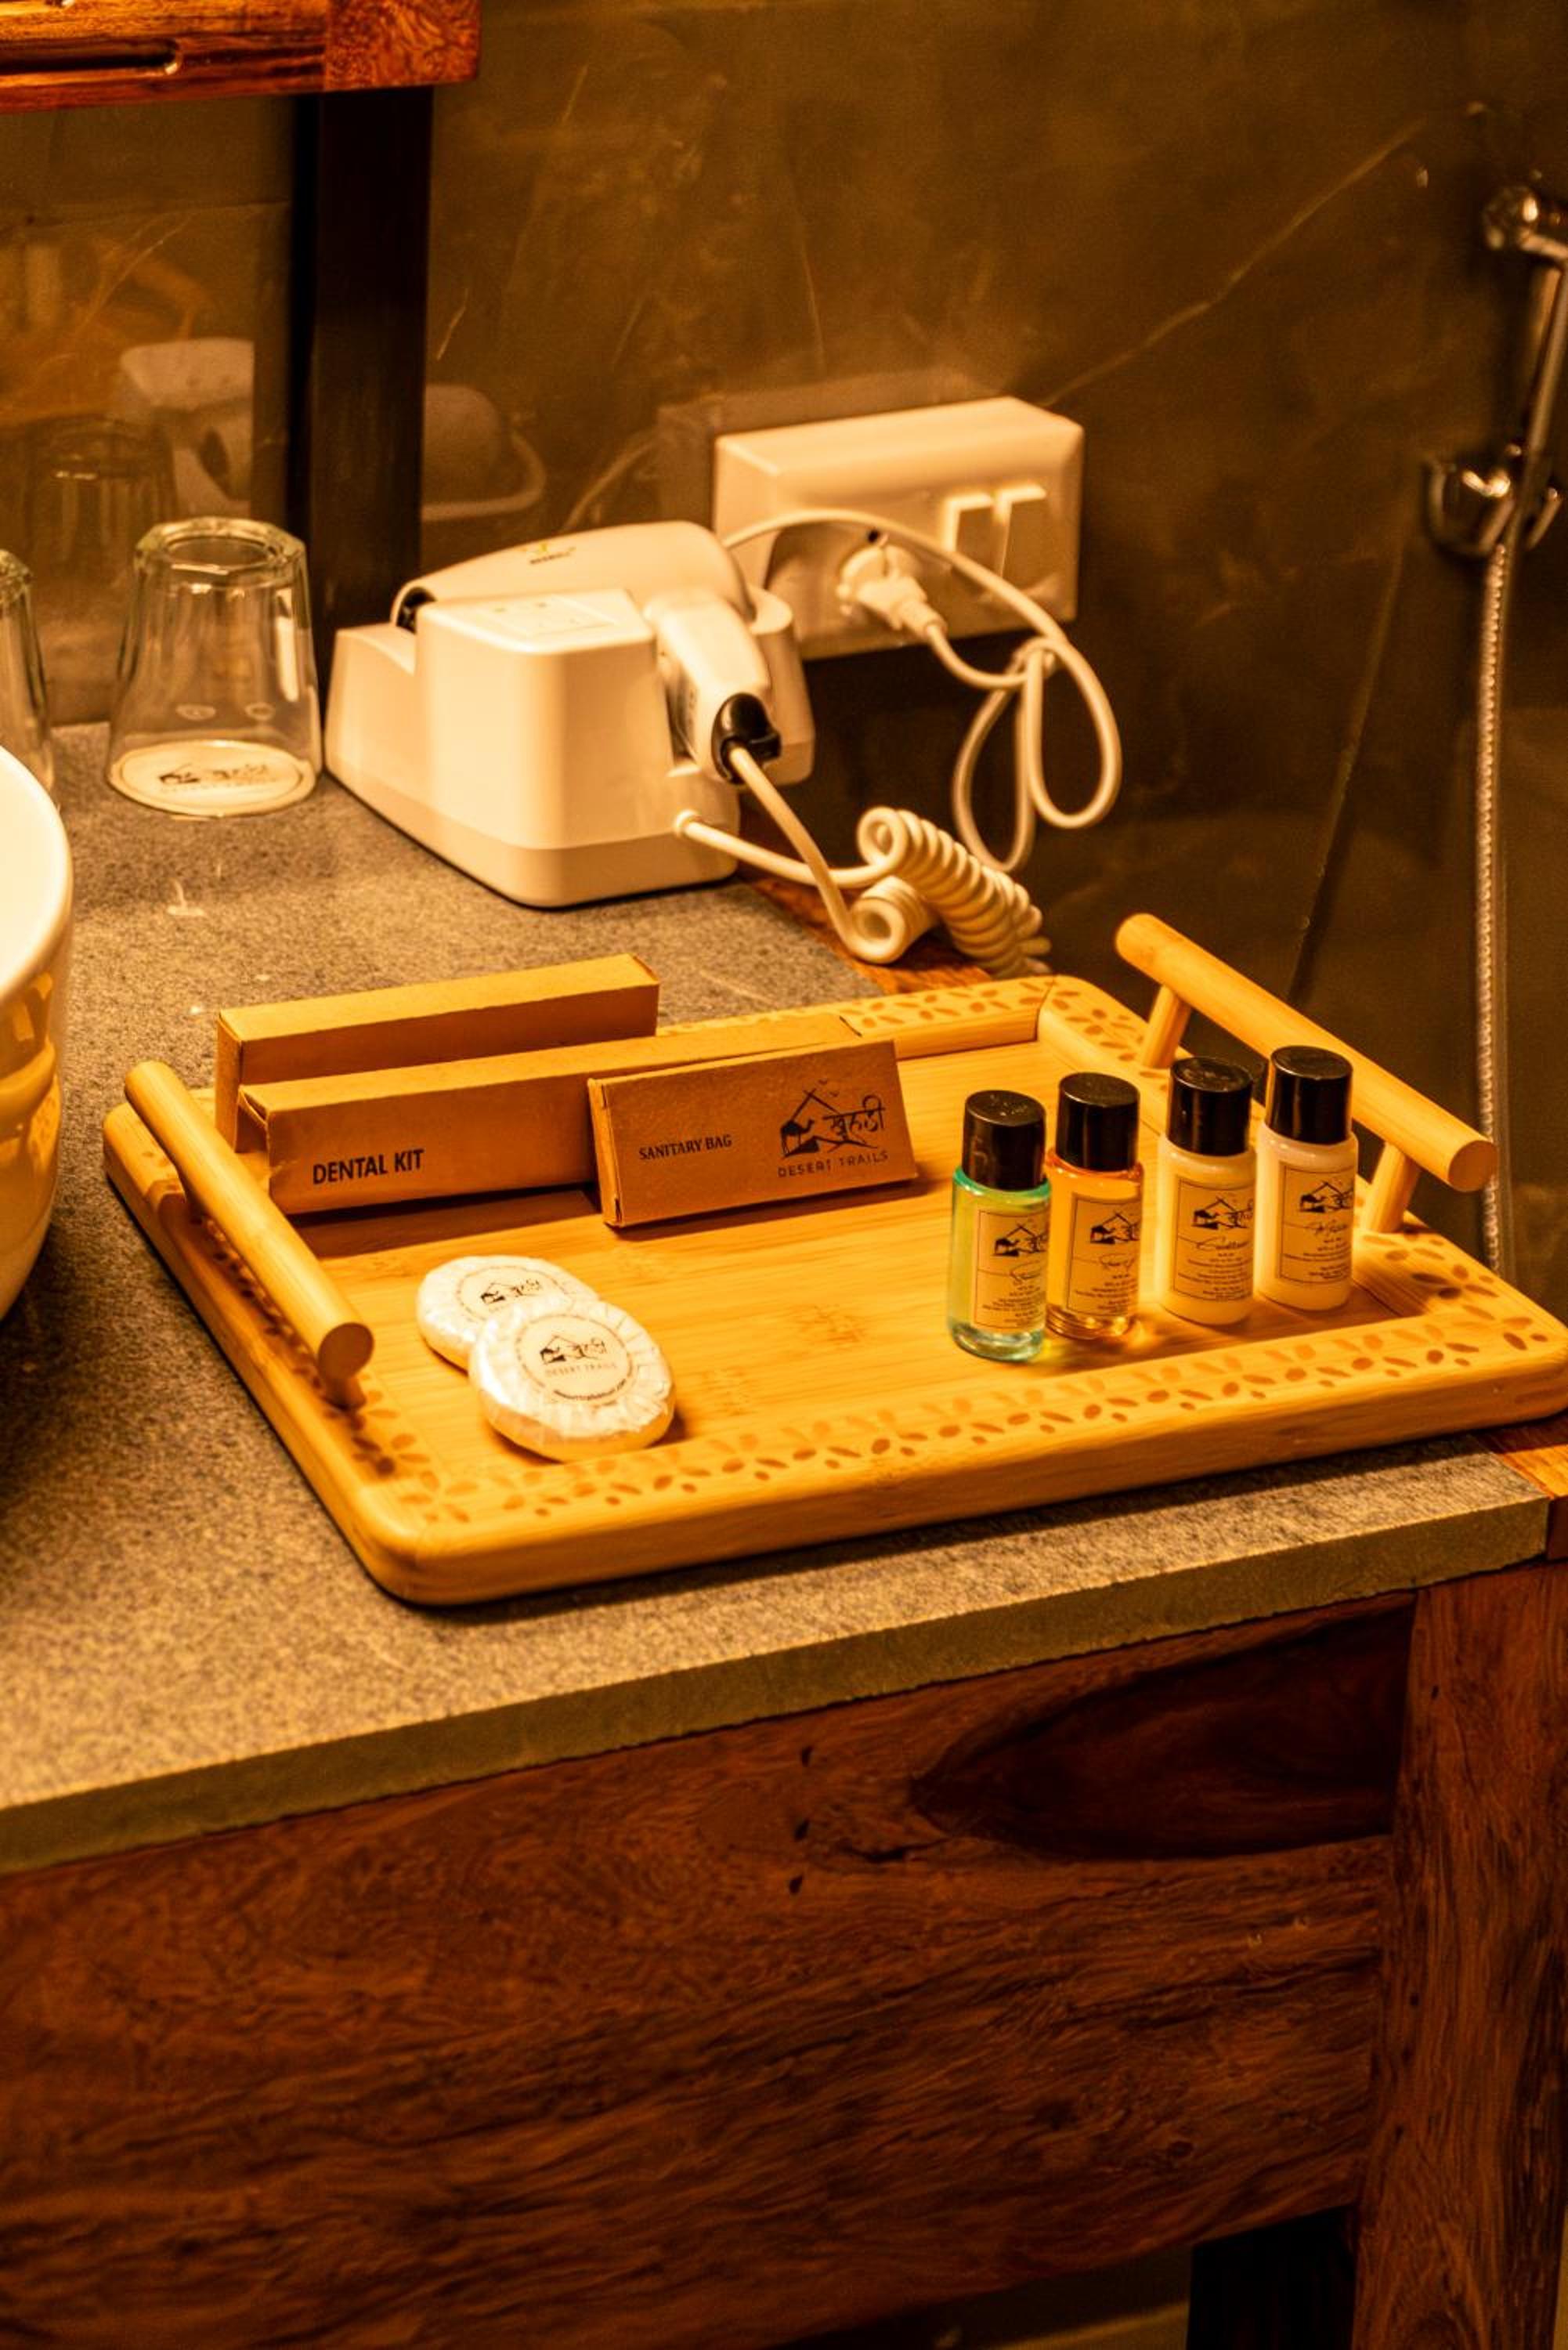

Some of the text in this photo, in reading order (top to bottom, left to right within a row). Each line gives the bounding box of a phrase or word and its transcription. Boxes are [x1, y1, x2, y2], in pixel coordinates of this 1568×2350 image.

[638, 1133, 732, 1161] SANITARY BAG
[313, 1148, 425, 1185] DENTAL KIT
[777, 1149, 889, 1178] DESERT TRAILS
